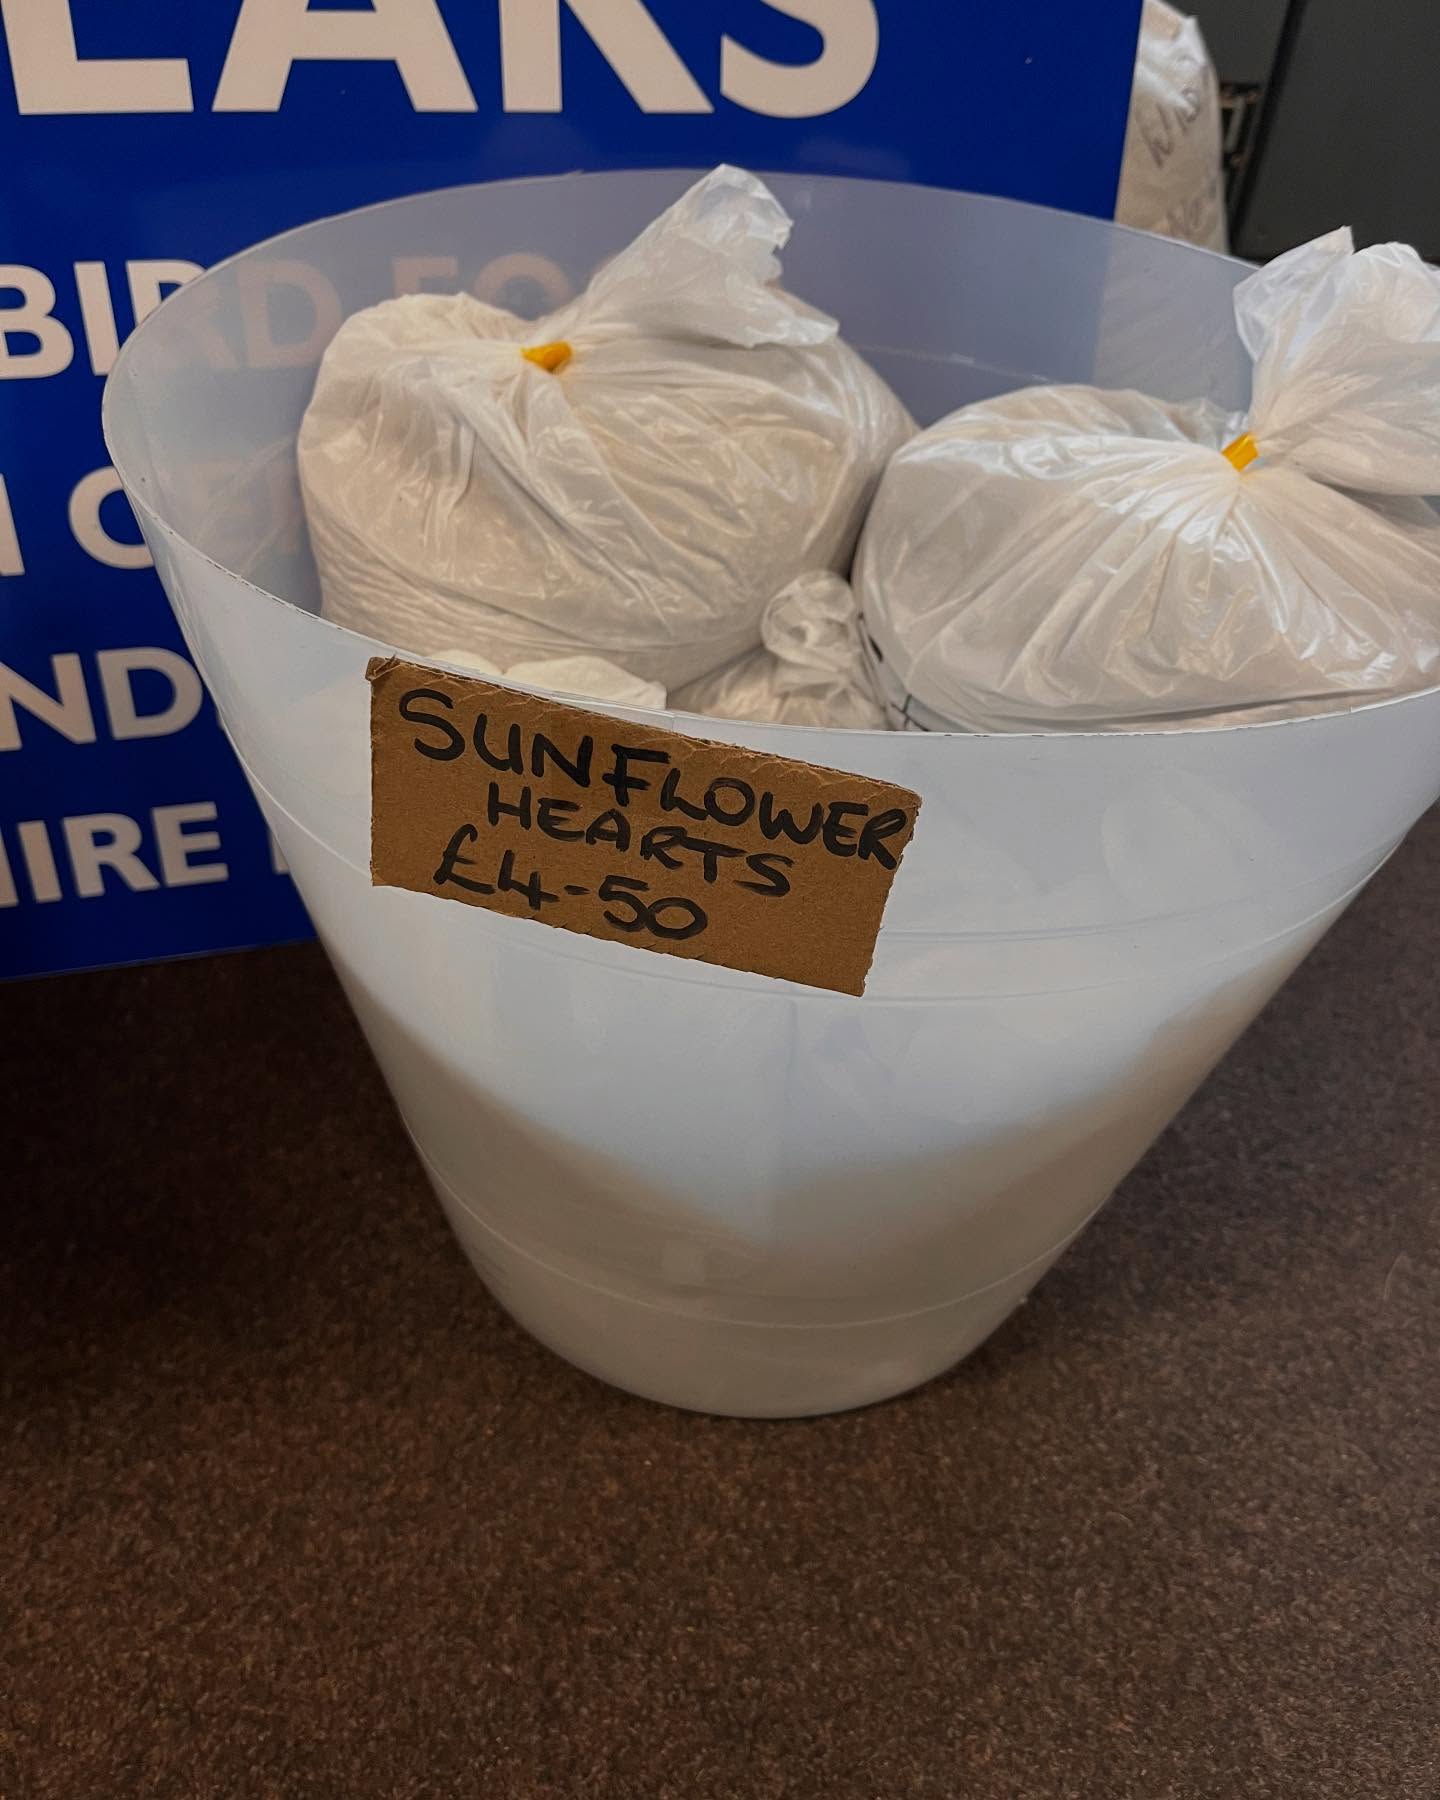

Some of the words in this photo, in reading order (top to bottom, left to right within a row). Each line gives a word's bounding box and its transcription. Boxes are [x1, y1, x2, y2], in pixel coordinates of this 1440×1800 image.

[399, 688, 908, 870] SUNFLOWER
[432, 823, 708, 940] £4-50
[488, 782, 794, 897] HEARTS
